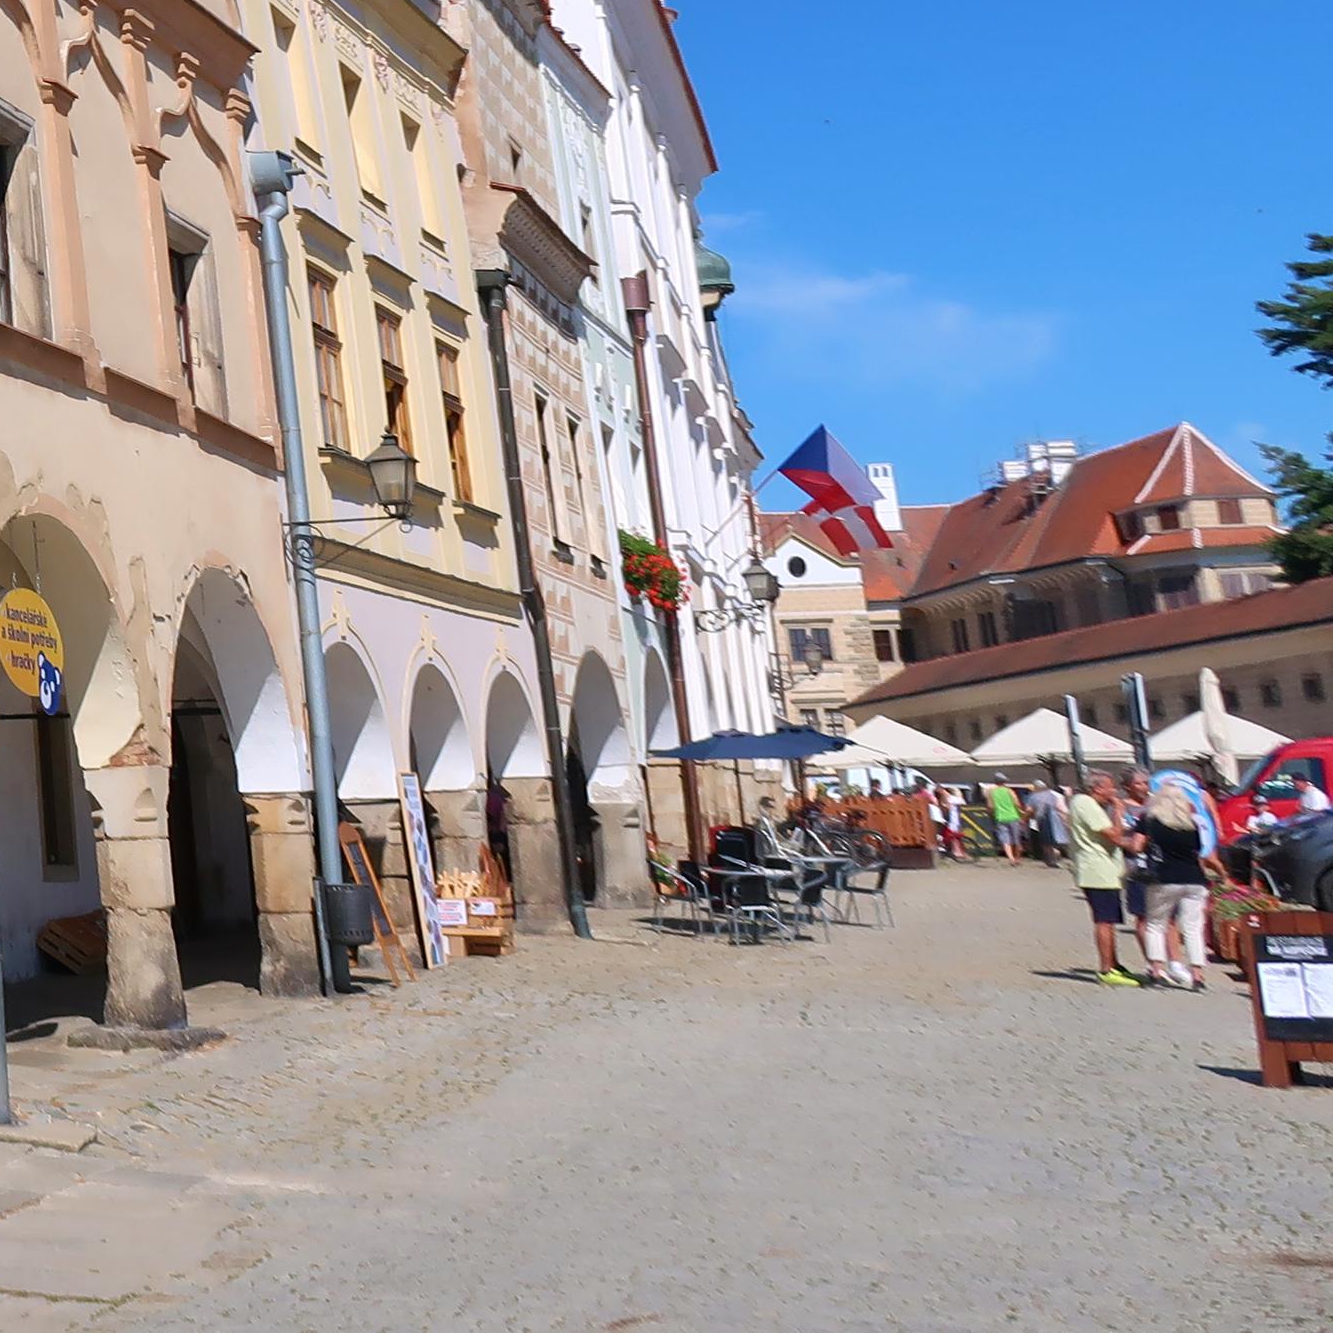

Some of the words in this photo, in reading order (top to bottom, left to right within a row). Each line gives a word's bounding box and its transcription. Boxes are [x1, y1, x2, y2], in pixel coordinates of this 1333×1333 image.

[5, 602, 47, 627] kancelářské
[1, 626, 7, 639] a
[7, 623, 30, 644] školní
[31, 631, 57, 653] potřeby
[10, 649, 36, 675] hračky
